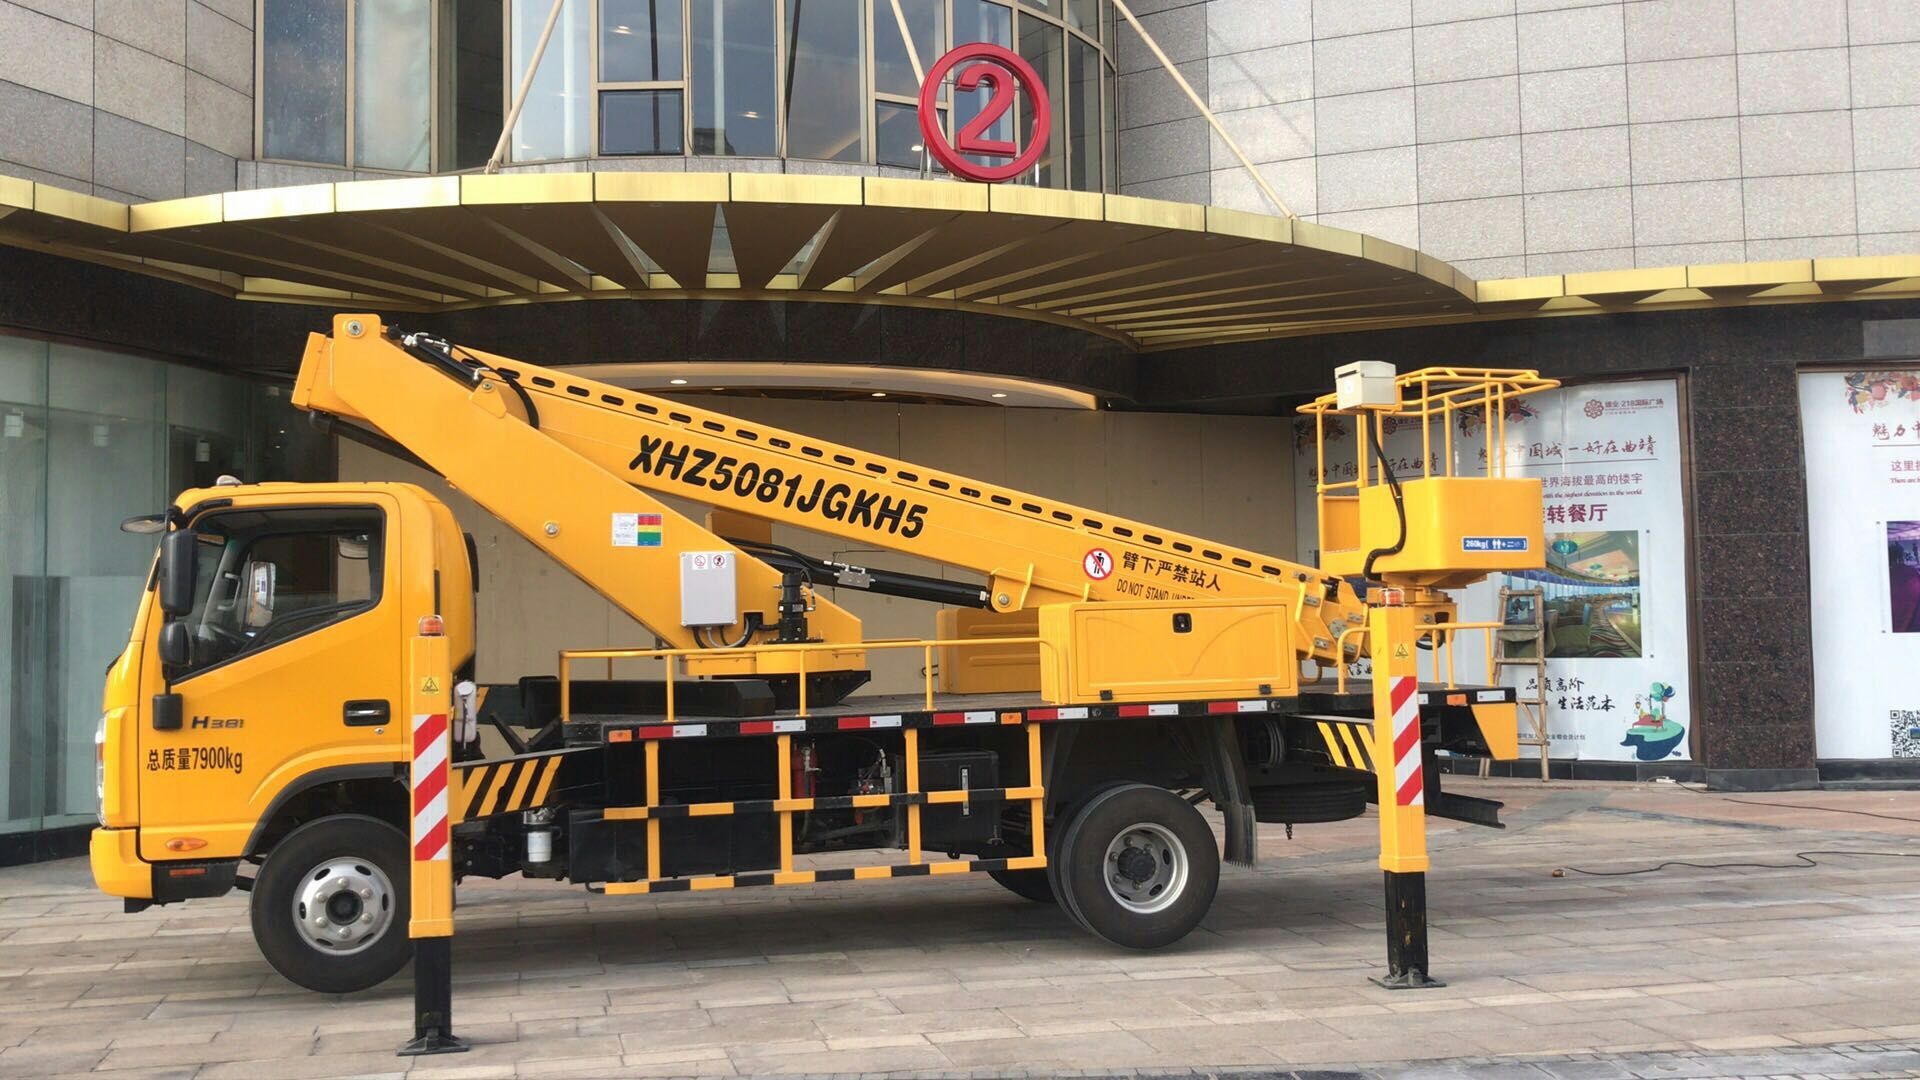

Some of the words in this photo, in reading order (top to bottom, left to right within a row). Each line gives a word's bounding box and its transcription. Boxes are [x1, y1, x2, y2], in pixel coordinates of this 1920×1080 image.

[629, 434, 929, 539] XHZ5081JGKH5
[1543, 503, 1608, 524] 转餐厅
[1123, 551, 1221, 592] 臂下严禁站人
[1116, 578, 1128, 592] DO
[1129, 581, 1144, 597] NOT
[1557, 694, 1616, 712] 生活范本
[147, 746, 243, 774] 总质量7900kg
